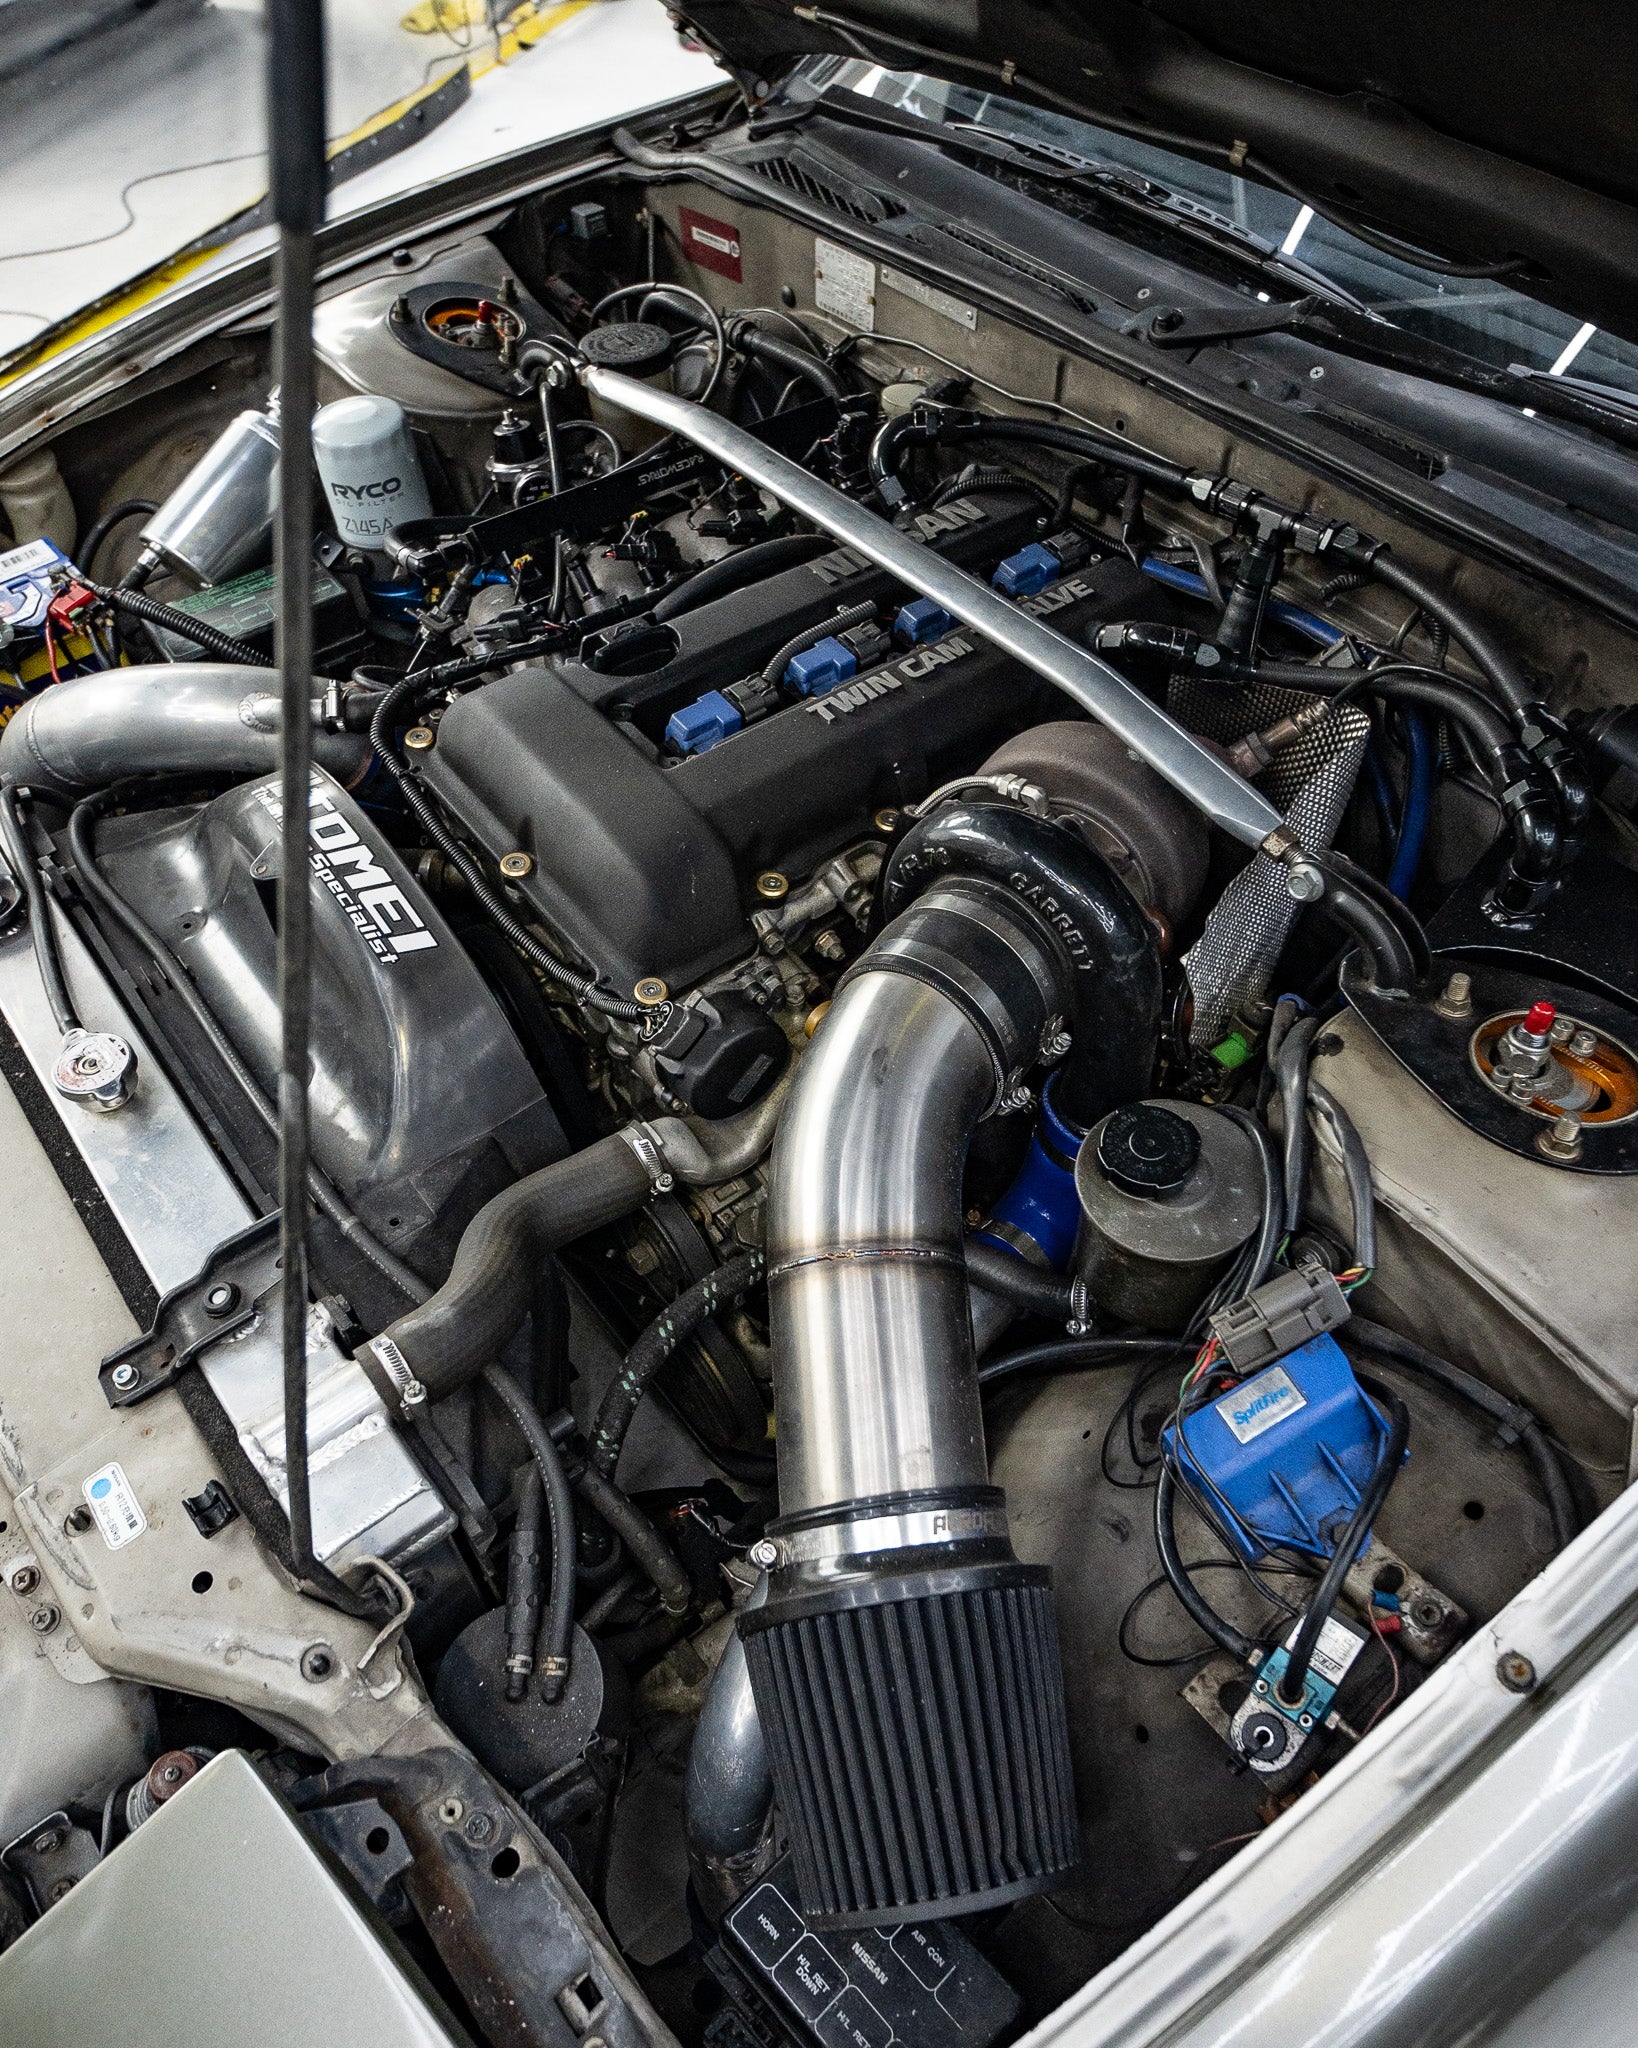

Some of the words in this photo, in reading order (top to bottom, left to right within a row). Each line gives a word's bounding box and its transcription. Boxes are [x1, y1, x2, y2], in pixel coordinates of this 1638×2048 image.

[331, 477, 401, 500] RYCO
[637, 454, 705, 486] RACEWORKS
[342, 516, 395, 536] Z145A
[806, 499, 986, 585] NISAN
[806, 671, 902, 723] TWIN
[898, 636, 975, 678] CAM
[1021, 579, 1096, 615] ALVE
[308, 787, 439, 954] TOMEI
[308, 852, 399, 964] Specialist
[1009, 872, 1094, 970] GARRETT
[1233, 1385, 1290, 1425] SplitFire
[757, 1913, 780, 1941] HORN
[851, 1941, 889, 1985] NISSAN
[910, 1929, 927, 1946] AIR
[926, 1946, 945, 1968] CON
[795, 1966, 820, 1996] DOWN
[796, 1953, 812, 1973] H/L
[811, 1972, 831, 1993] RET
[836, 2010, 850, 2030] H/L
